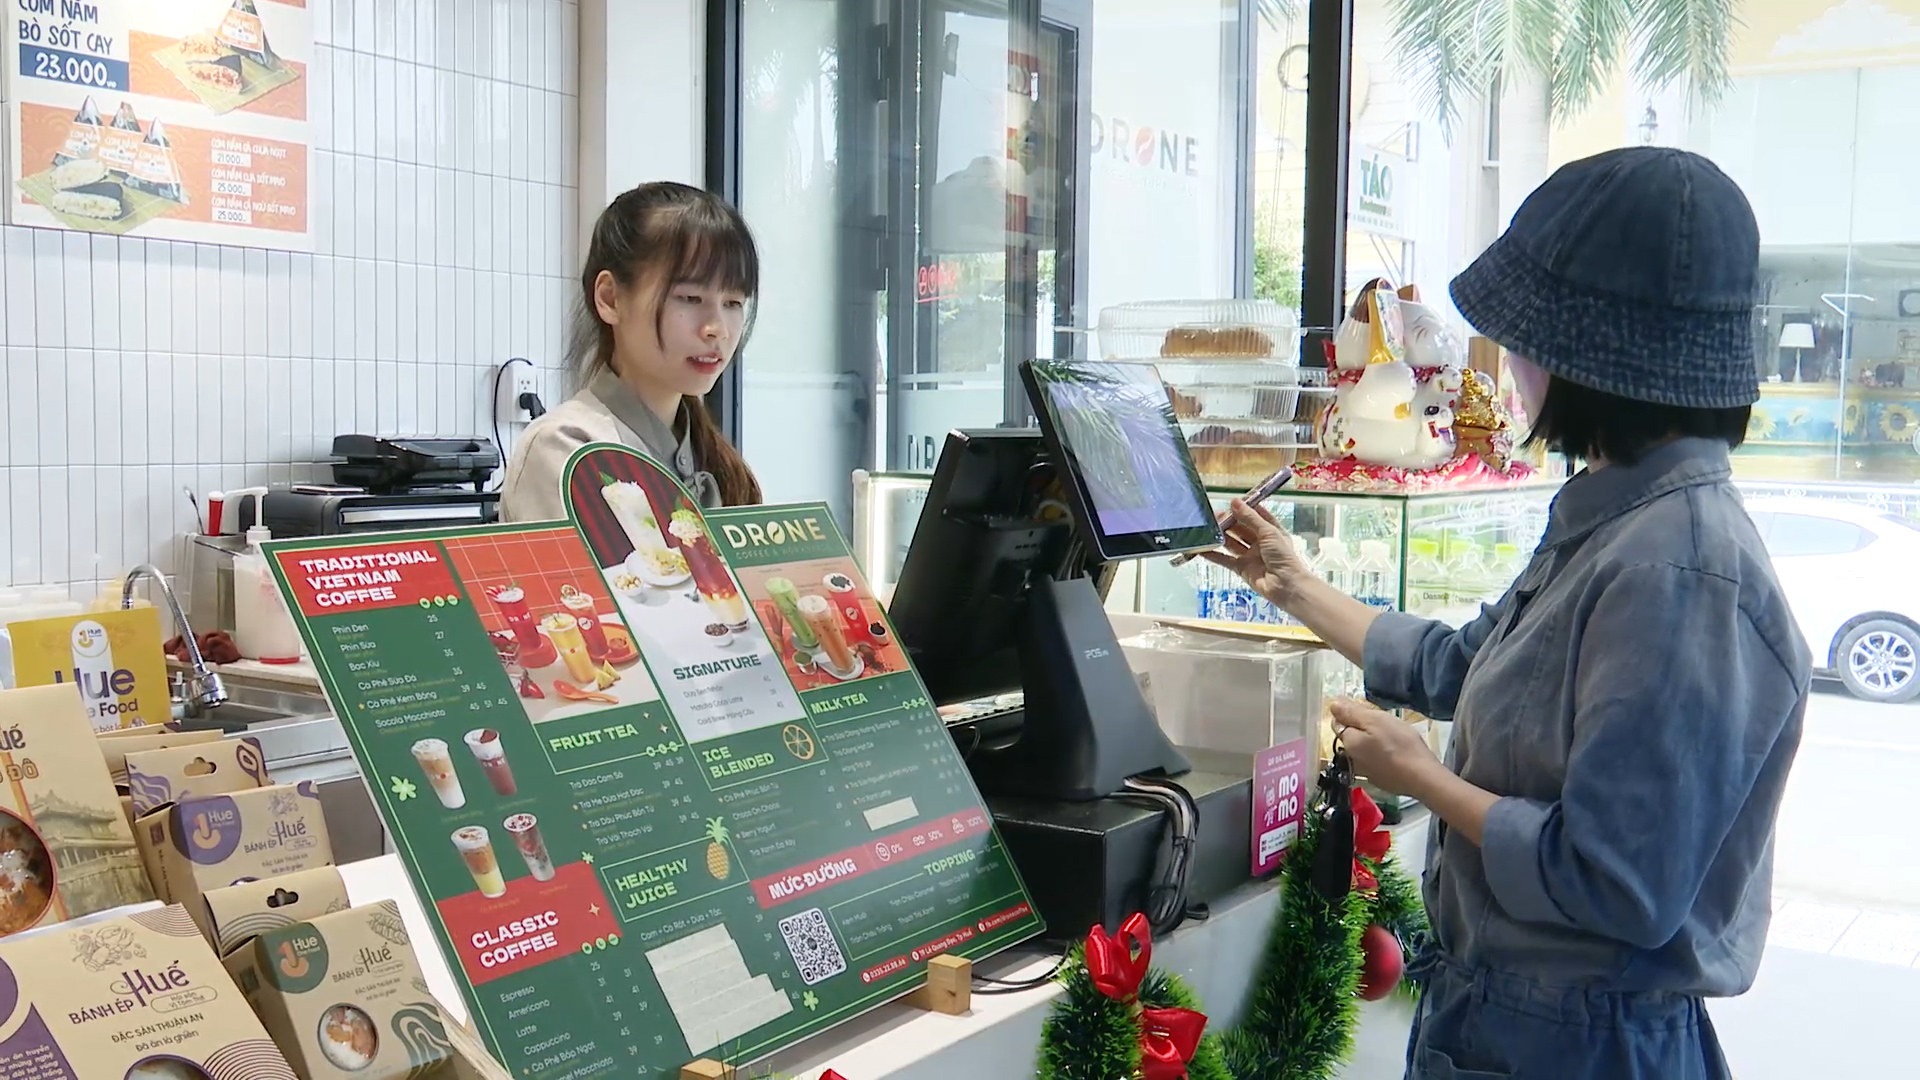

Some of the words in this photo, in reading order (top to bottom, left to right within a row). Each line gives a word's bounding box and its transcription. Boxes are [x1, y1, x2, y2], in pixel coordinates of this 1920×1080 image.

[19, 17, 41, 42] BÒ
[48, 21, 81, 49] SỐT
[87, 33, 113, 55] CAY
[35, 52, 108, 86] 23.000
[1361, 153, 1393, 202] TÁO
[722, 518, 826, 549] DRONE
[299, 550, 437, 574] TRADITIONAL
[307, 569, 402, 591] VIETNAM
[316, 587, 397, 608] COFFEE
[427, 614, 438, 623] 25
[443, 648, 454, 657] 35
[452, 666, 463, 676] 35
[673, 654, 762, 681] SIGNATURE
[476, 681, 486, 691] 45
[99, 698, 138, 717] Food
[470, 702, 480, 711] 45
[497, 697, 508, 706] 45
[811, 697, 842, 715] MILK
[841, 692, 869, 708] TEA
[549, 730, 603, 752] FRUIT
[602, 723, 639, 742] TEA
[702, 746, 732, 764] ICE
[709, 752, 775, 779] BLENDED
[208, 810, 233, 823] Hue
[924, 849, 976, 876] TOPPING
[614, 858, 689, 892] HEALTHY
[625, 882, 679, 909] JUICE
[471, 910, 559, 949] CLASSIC
[292, 936, 318, 951] Hue
[479, 932, 558, 969] COFFEE
[112, 960, 190, 1008] Huế
[500, 985, 536, 1003] Espresso
[68, 1003, 116, 1025] BÁNH
[115, 998, 135, 1014] ÉP
[189, 1012, 204, 1024] AN
[508, 999, 550, 1020] Americano
[515, 1024, 537, 1038] Latte
[523, 1032, 571, 1057] Cappuccino
